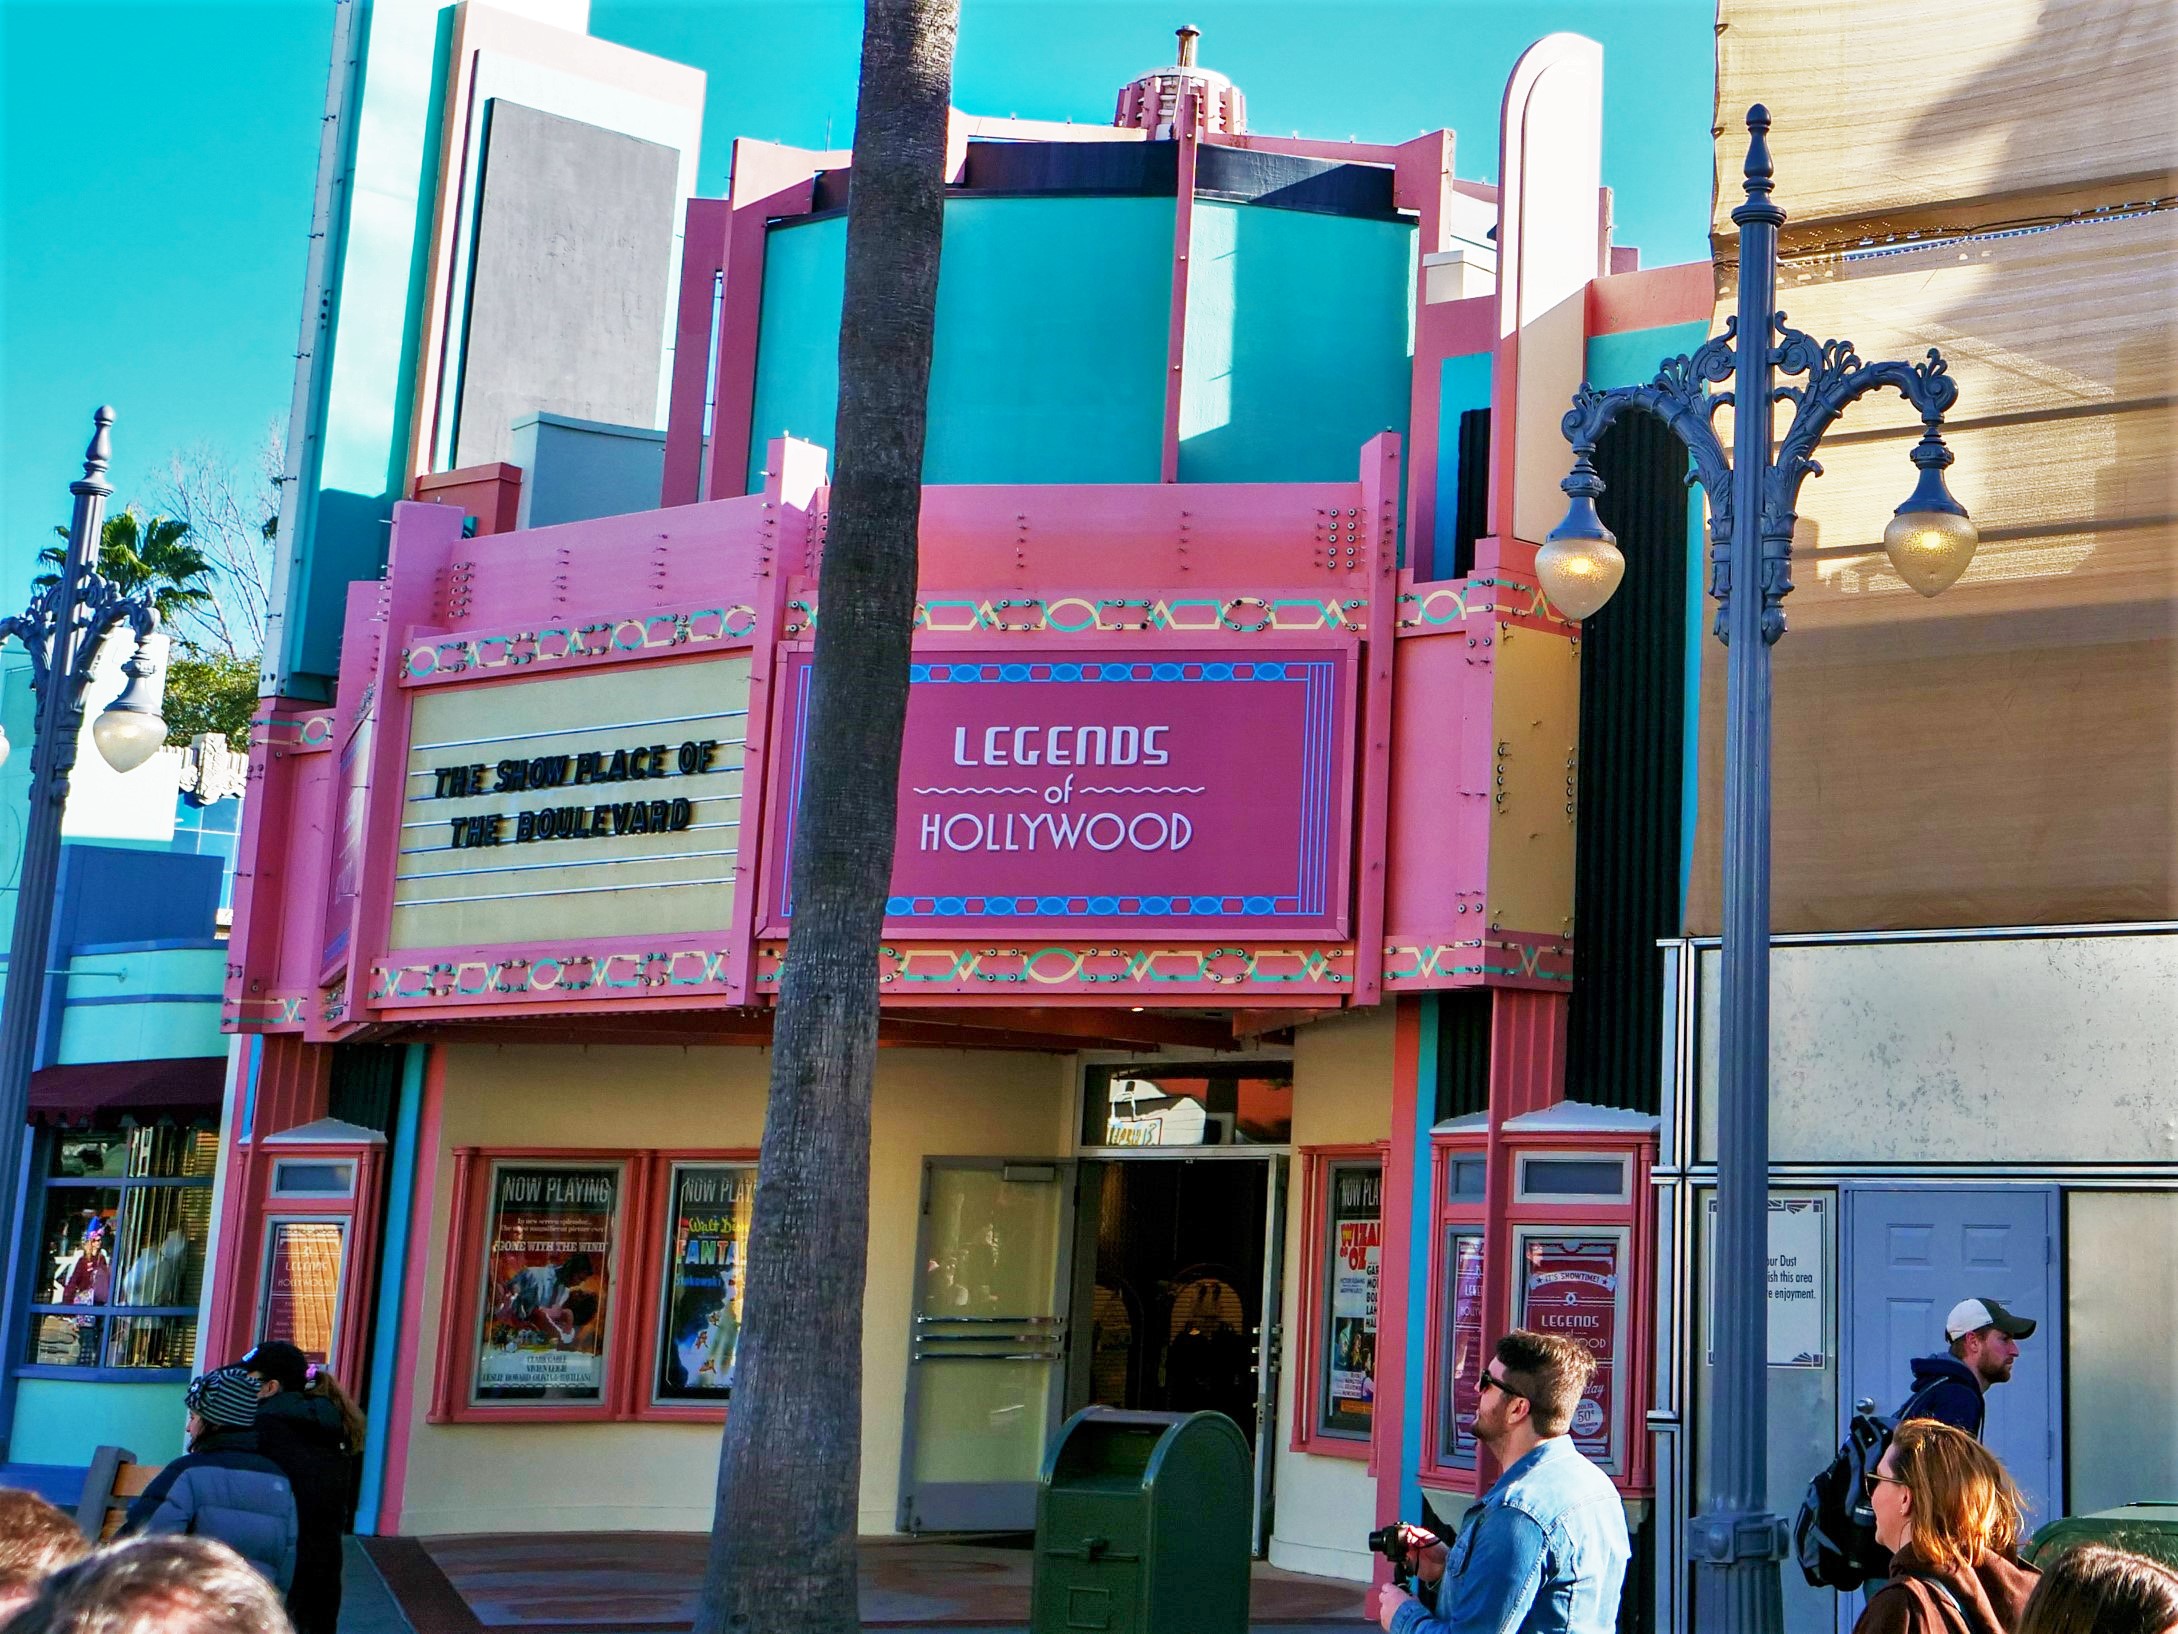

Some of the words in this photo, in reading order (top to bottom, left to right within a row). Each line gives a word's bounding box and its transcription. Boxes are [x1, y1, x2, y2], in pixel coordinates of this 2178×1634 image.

[954, 726, 1170, 766] LEGENDS
[434, 763, 486, 799] THE
[494, 755, 569, 792] SHOW
[575, 745, 666, 785] PLACE
[678, 739, 717, 776] OF
[1044, 773, 1074, 804] of
[451, 813, 502, 848] THE
[515, 797, 692, 843] BOULEVARD
[920, 812, 1193, 852] HOLLYWOOD
[504, 1176, 542, 1202] NOW
[545, 1177, 610, 1203] PLAYING
[685, 1178, 716, 1202] NOW
[720, 1178, 757, 1202] PLAY
[1342, 1178, 1361, 1206] NOW
[689, 1216, 719, 1233] Walt
[528, 1241, 554, 1252] WITH
[555, 1241, 577, 1252] THE
[1349, 1247, 1367, 1270] OZ
[1780, 1255, 1797, 1267] Dust
[1545, 1274, 1558, 1282] IT'S
[1561, 1272, 1600, 1283] SHOWTIME!
[1780, 1270, 1794, 1283] this
[1796, 1274, 1813, 1283] area
[1775, 1288, 1816, 1301] enjoyment.
[1541, 1315, 1600, 1328] LEGENDS
[1576, 1338, 1606, 1348] OOD
